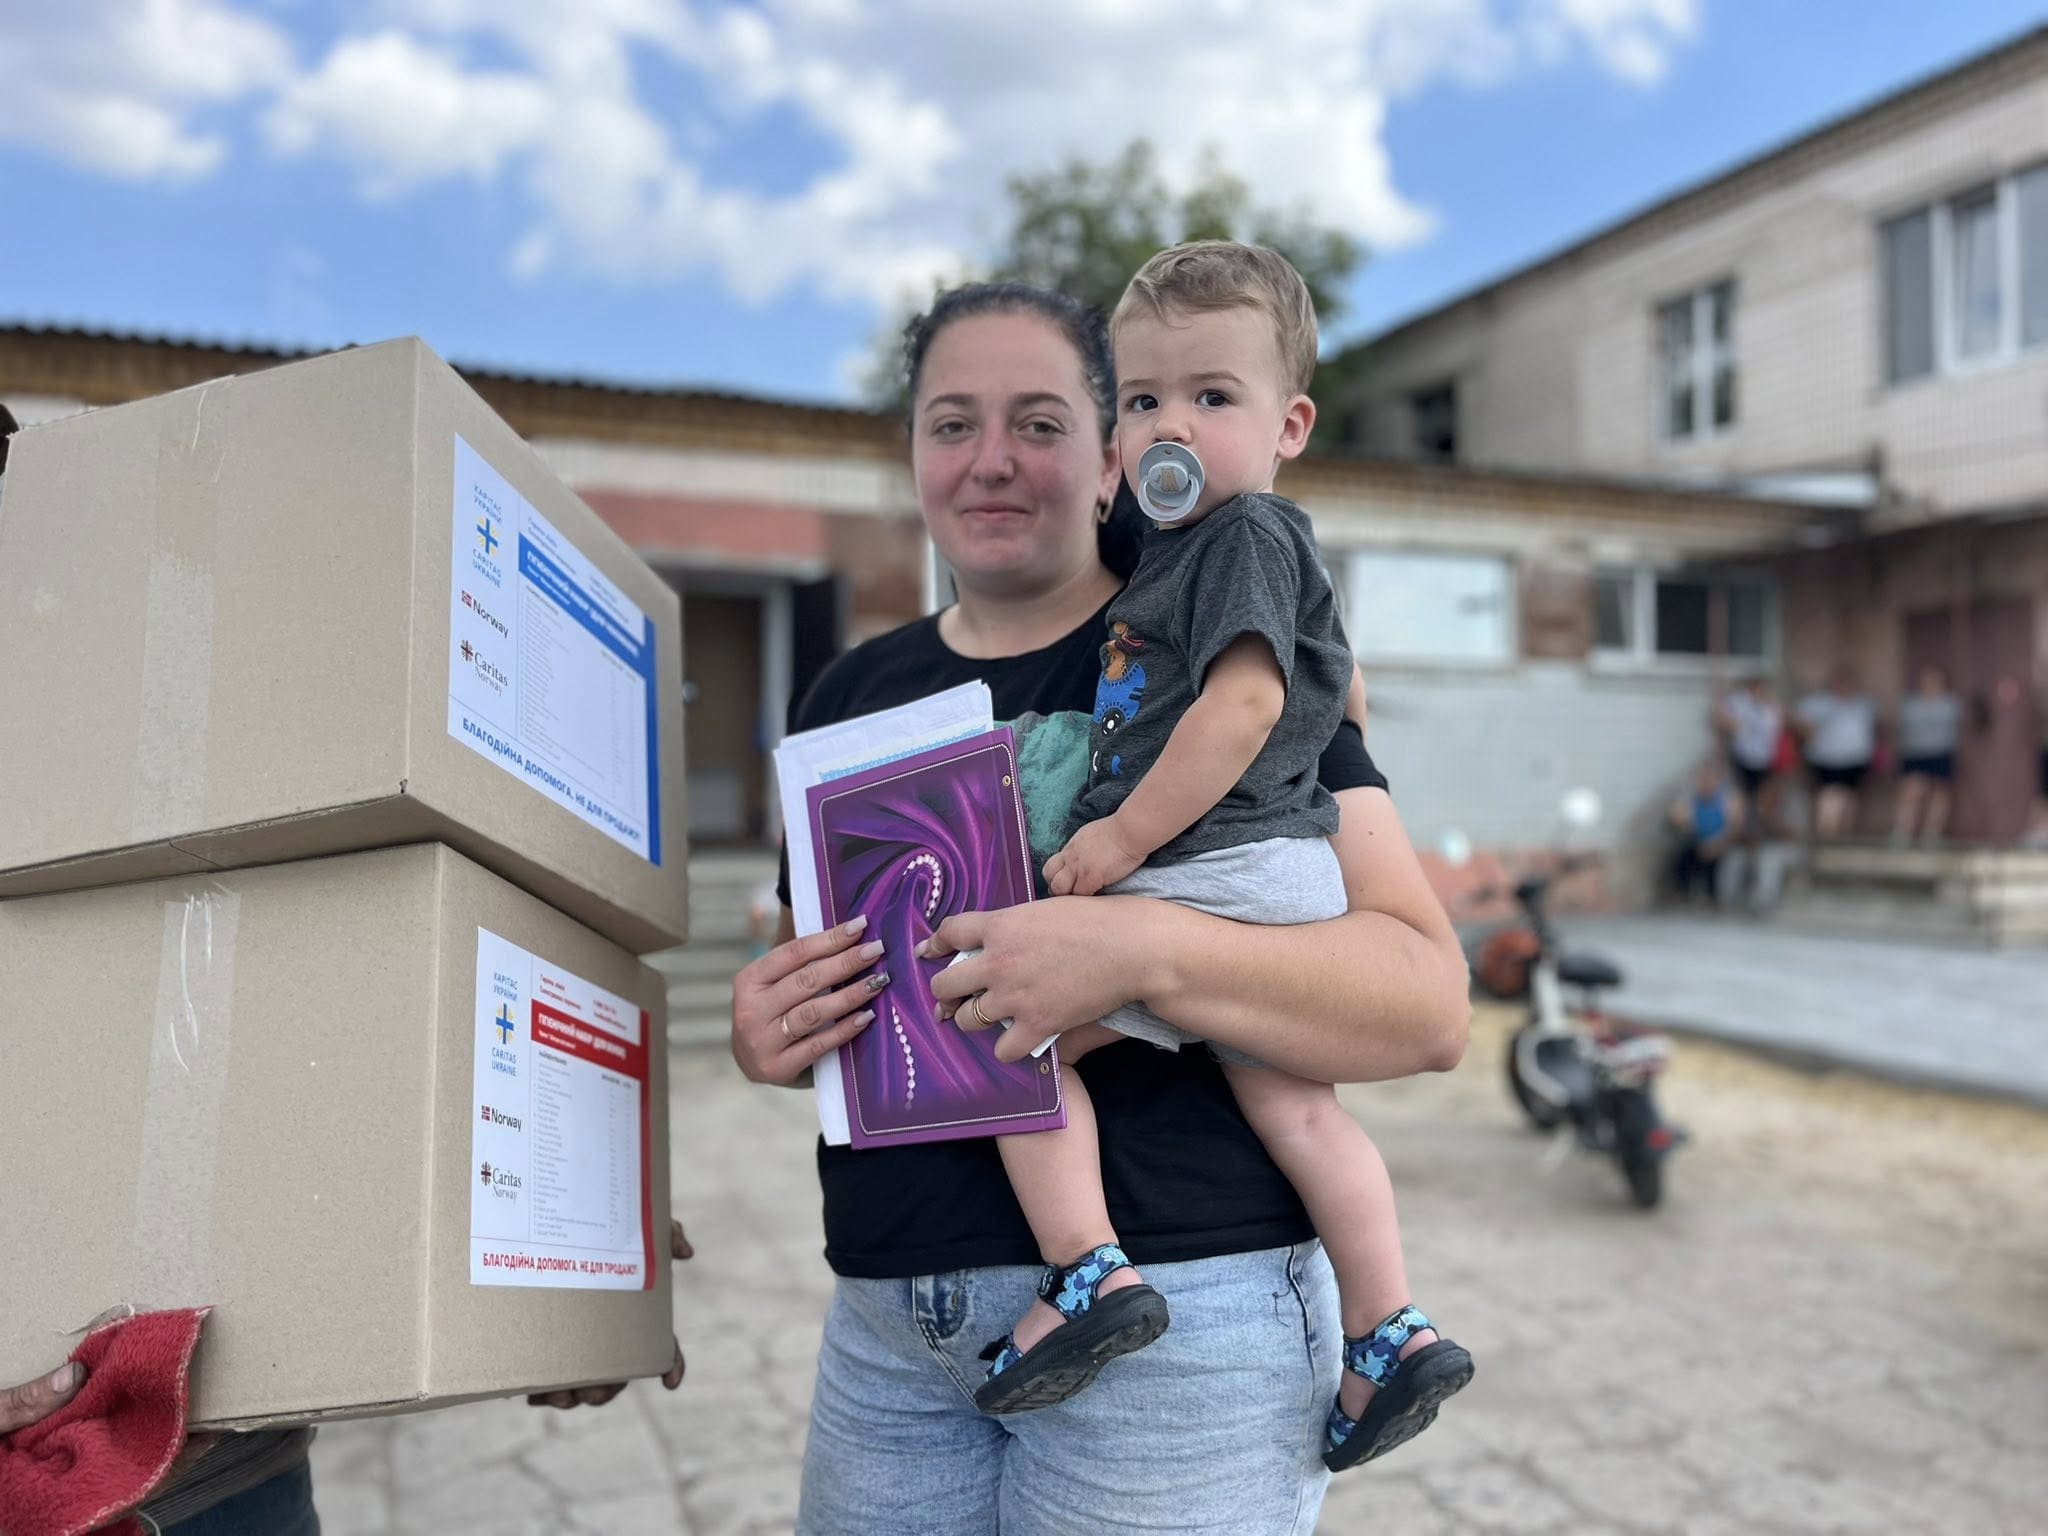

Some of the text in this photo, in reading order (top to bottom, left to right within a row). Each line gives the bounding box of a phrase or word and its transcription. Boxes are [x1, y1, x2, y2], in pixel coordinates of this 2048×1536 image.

[472, 548, 502, 579] CARITAS
[472, 560, 502, 589] UKRAINE
[473, 599, 510, 640] Norway
[474, 651, 509, 687] Caritas
[475, 666, 504, 697] Norway
[462, 717, 524, 767] БЛАГОДІЙНА
[491, 1047, 517, 1063] CARITAS
[491, 1061, 517, 1077] UKRAINE
[491, 1109, 522, 1132] Norway
[492, 1167, 522, 1188] Caritas
[492, 1186, 518, 1205] Norway
[483, 1252, 535, 1270] БЛАГОДІЙНА
